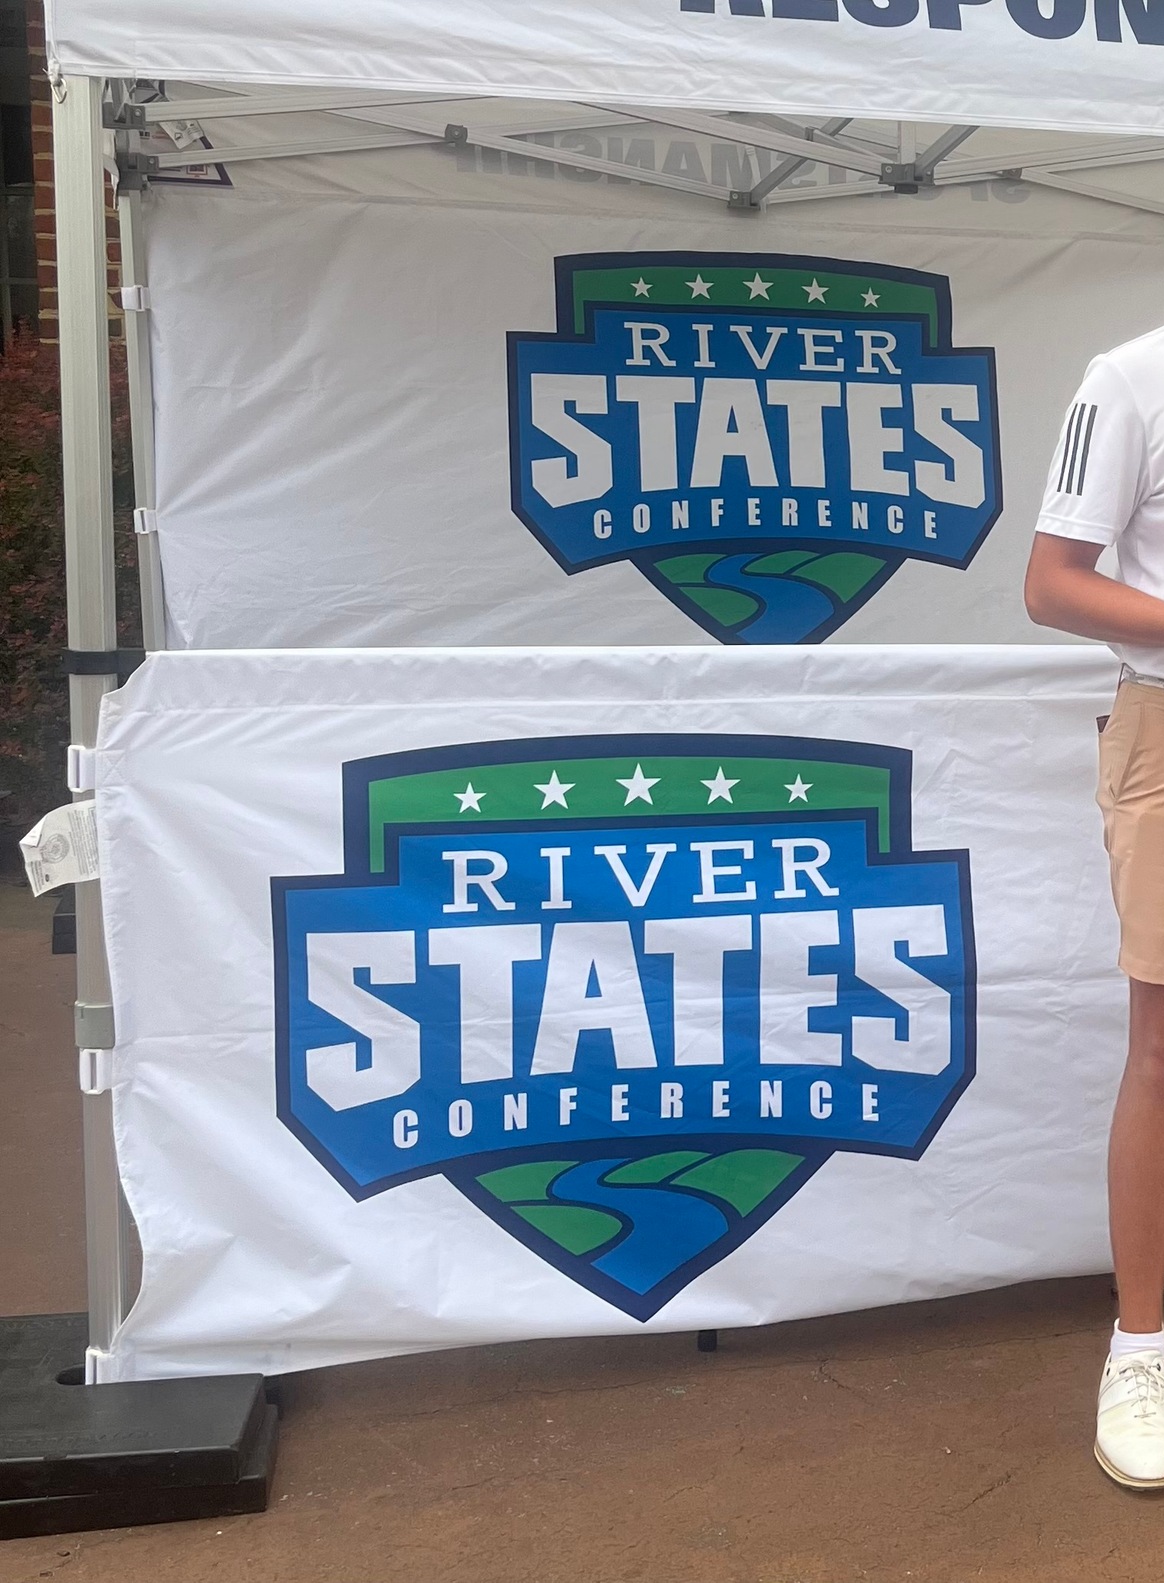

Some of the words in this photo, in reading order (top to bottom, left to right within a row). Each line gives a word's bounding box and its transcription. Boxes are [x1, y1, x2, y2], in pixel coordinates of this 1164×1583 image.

[623, 321, 902, 375] RIVER
[530, 372, 986, 510] STATES
[593, 497, 938, 540] CONFERENCE
[442, 838, 839, 913] RIVER
[305, 904, 952, 1112] STATES
[392, 1079, 881, 1149] CONFERENCE
